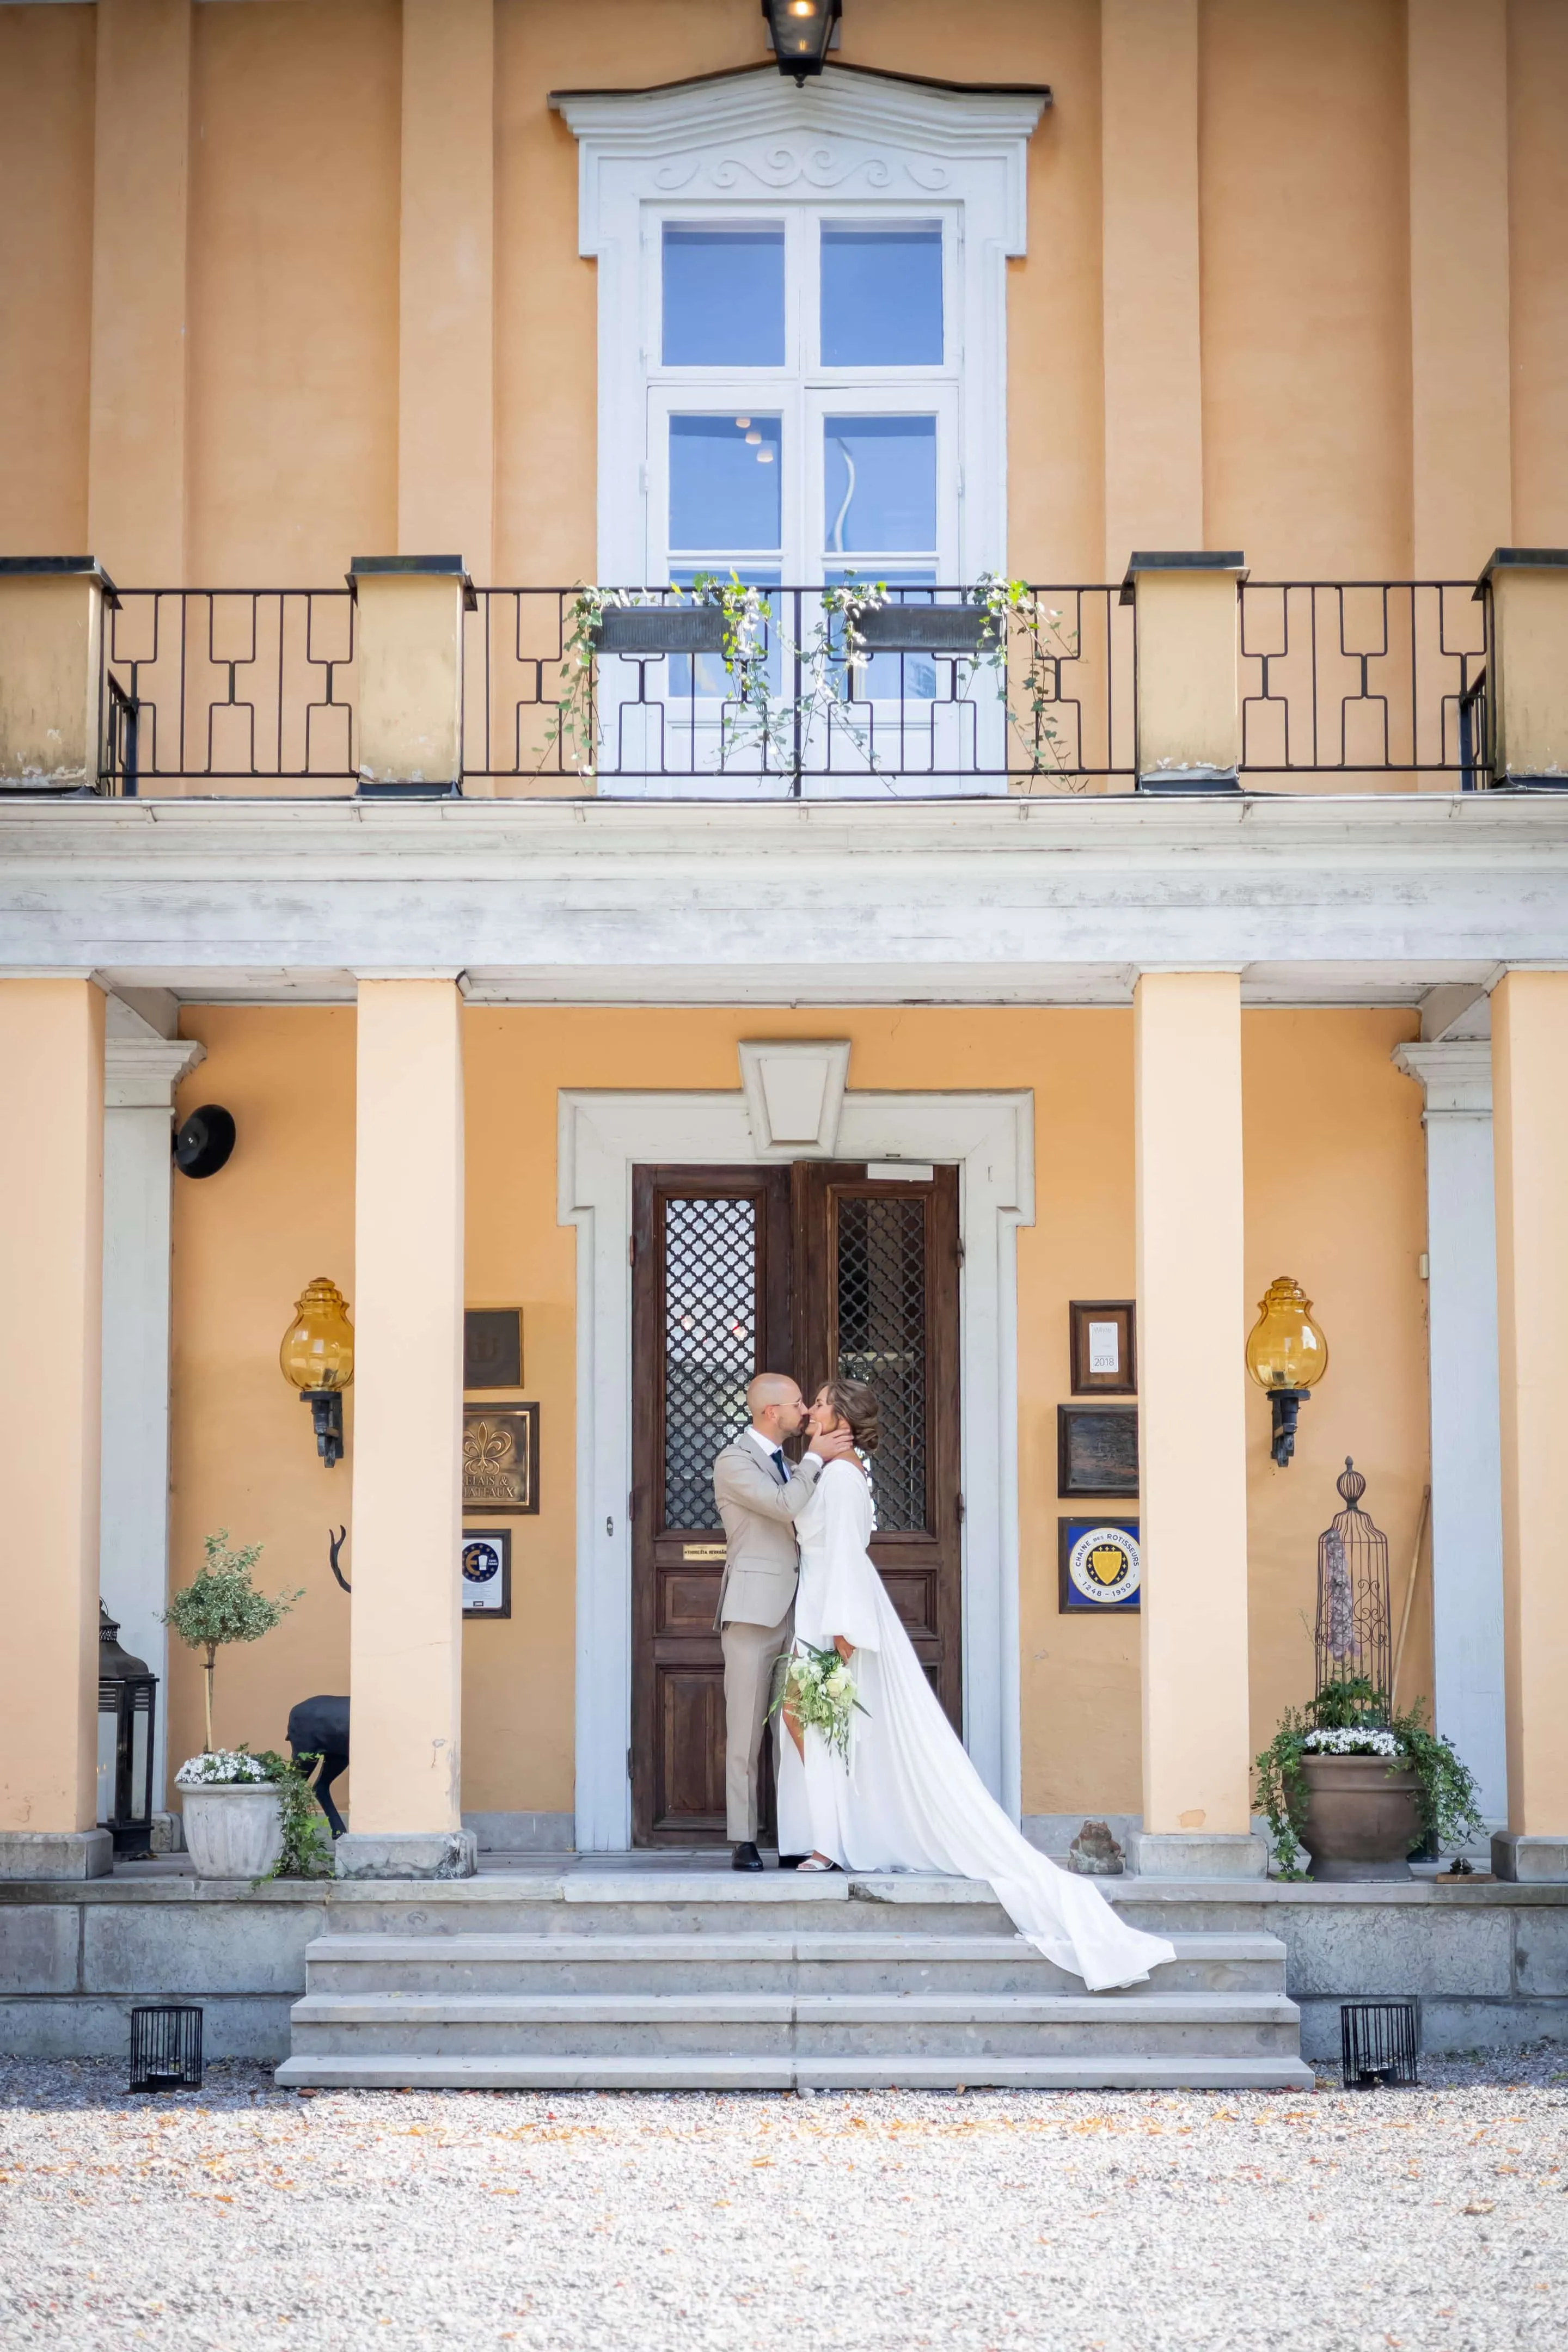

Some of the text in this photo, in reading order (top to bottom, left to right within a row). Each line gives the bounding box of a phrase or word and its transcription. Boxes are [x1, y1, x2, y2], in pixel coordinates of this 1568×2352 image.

[1094, 1358, 1114, 1367] 2018
[500, 1476, 508, 1486] &
[1075, 1540, 1091, 1567] CHAINE
[1107, 1533, 1139, 1566] ROTISSEURS
[1082, 1581, 1102, 1597] 1248
[1112, 1583, 1131, 1597] 1950
